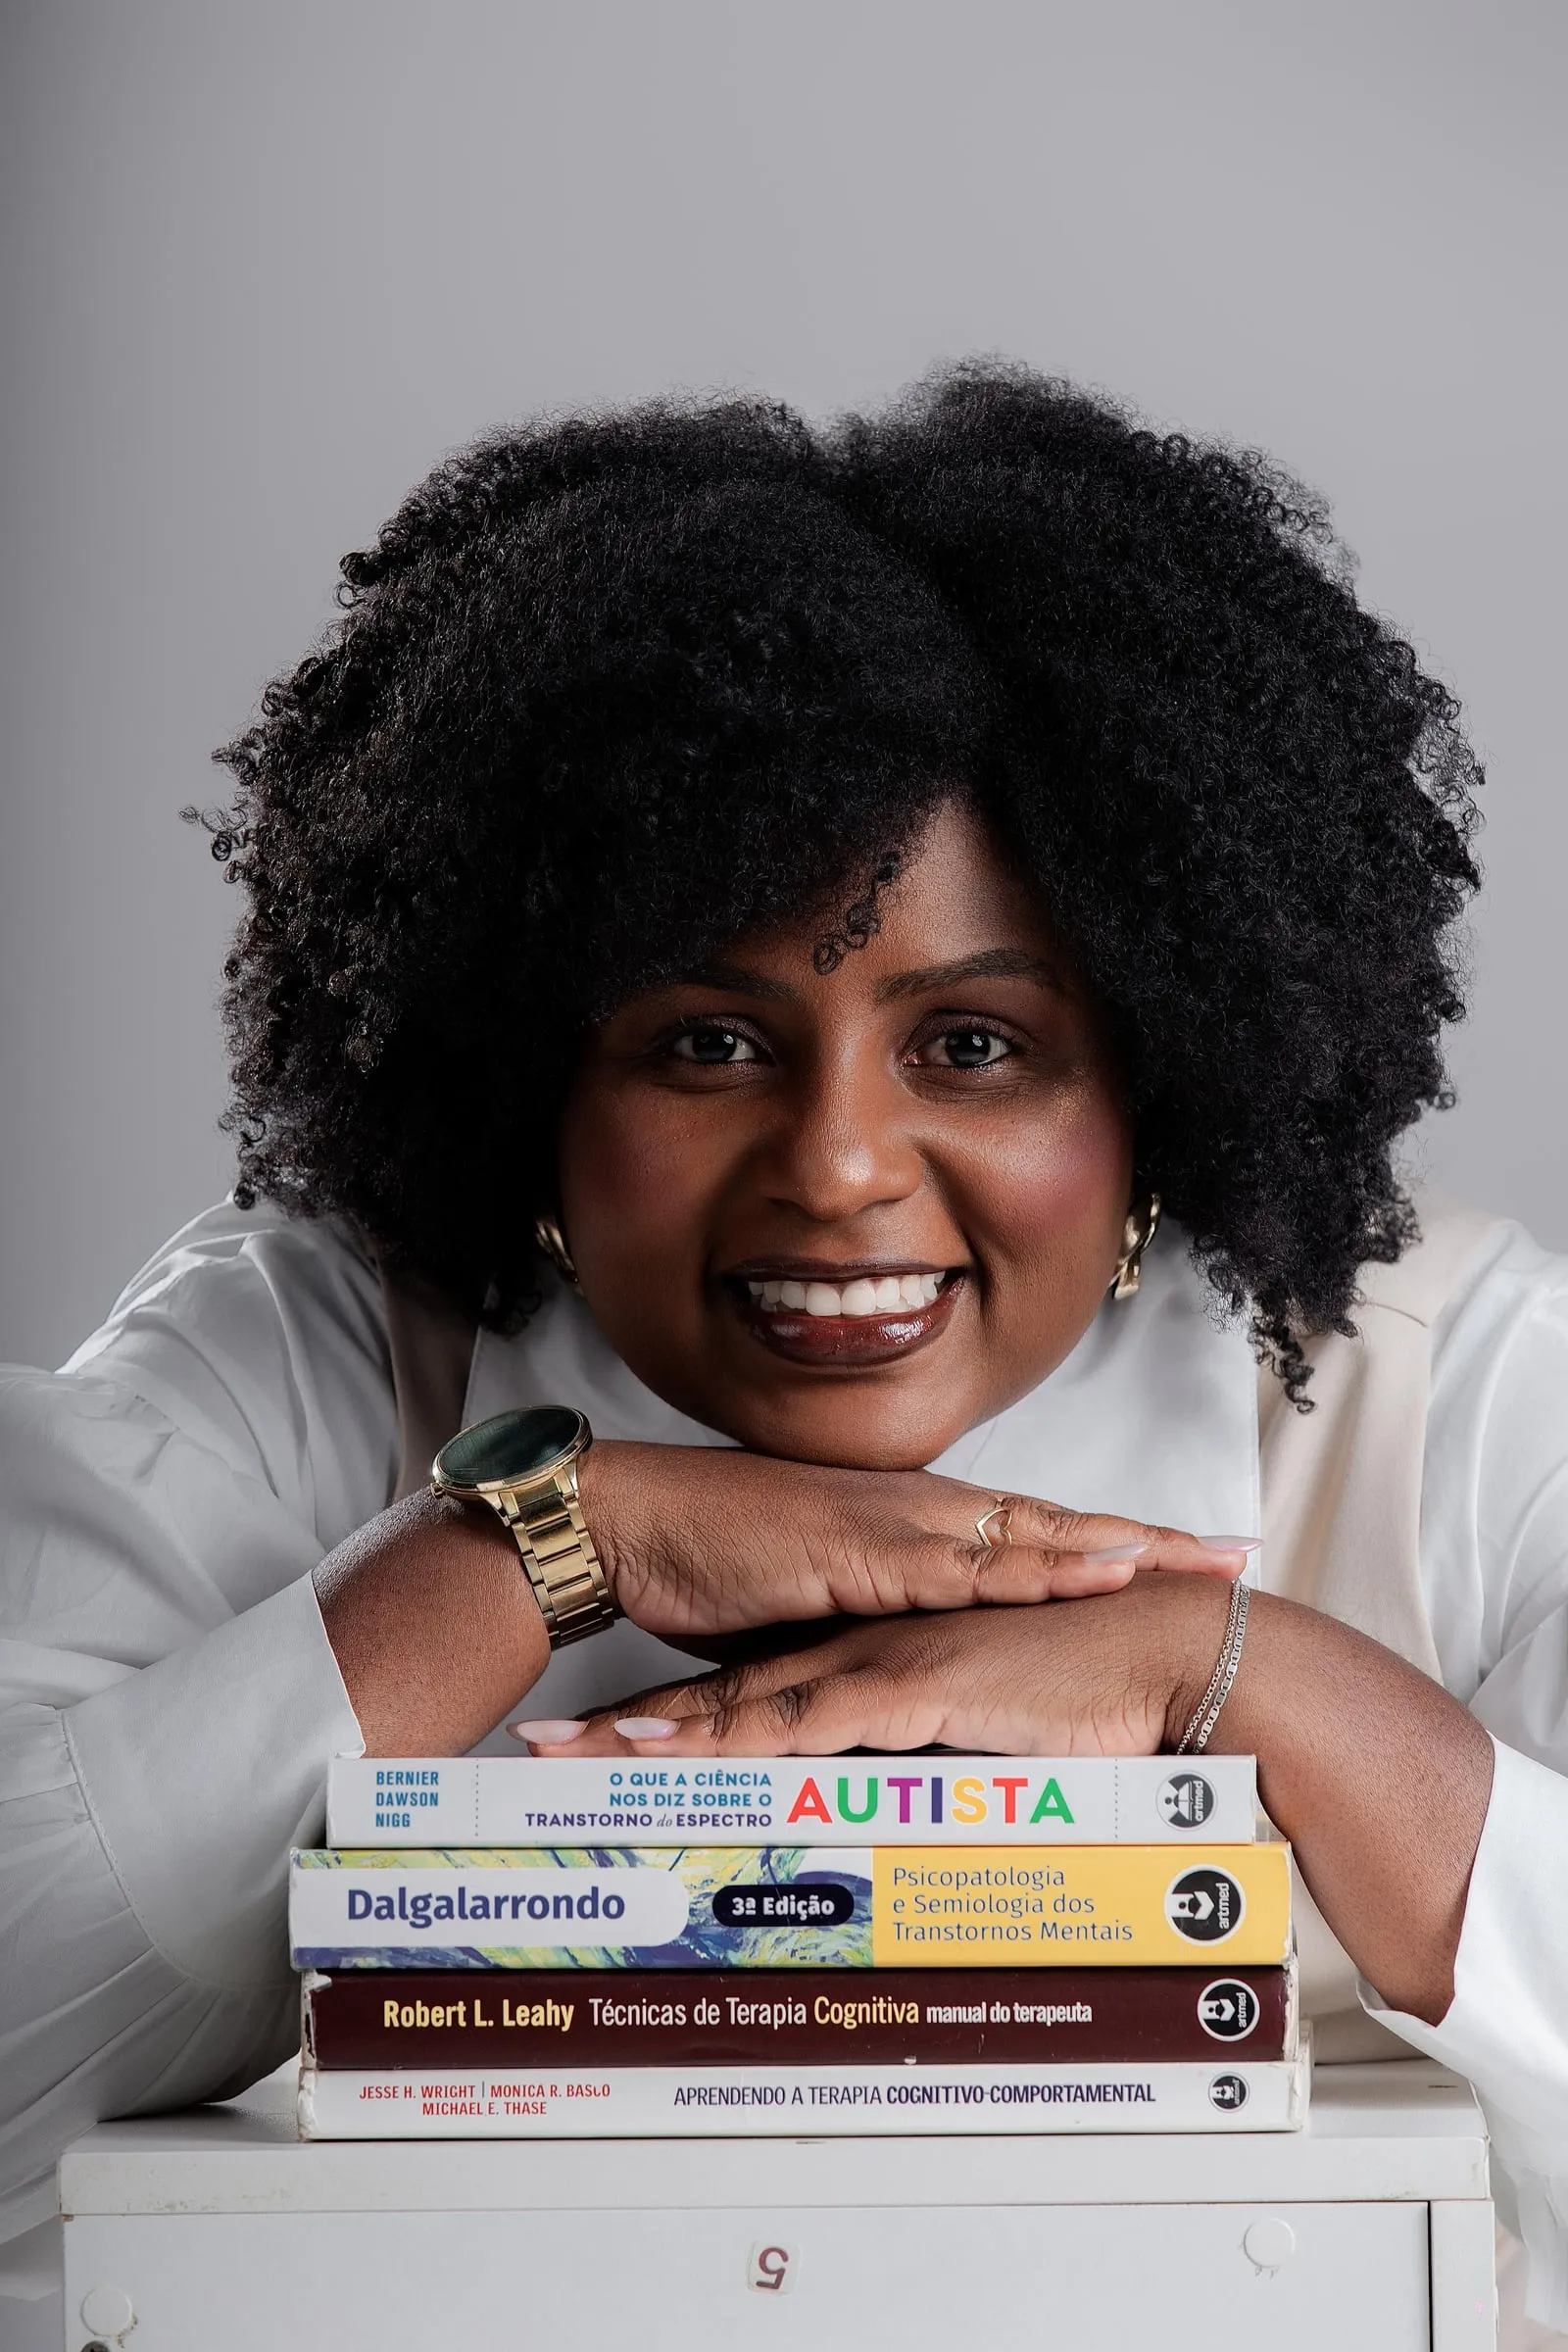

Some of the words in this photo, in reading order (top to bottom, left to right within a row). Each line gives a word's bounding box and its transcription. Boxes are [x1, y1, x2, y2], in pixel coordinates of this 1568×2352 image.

[375, 1771, 439, 1787] BERNIER
[610, 1772, 623, 1787] O
[629, 1772, 668, 1787] QUE
[674, 1773, 688, 1787] A
[694, 1769, 772, 1787] CIÊNCIA
[375, 1791, 439, 1807] DAWSON
[610, 1792, 649, 1807] NOS
[654, 1792, 686, 1807] DIZ
[691, 1792, 753, 1807] SOBRE
[759, 1792, 772, 1807] O
[786, 1776, 1075, 1825] AUTISTA
[1193, 1780, 1204, 1822] artmed
[375, 1812, 411, 1828] NIGG
[524, 1813, 653, 1828] TRANSTORNO
[656, 1812, 673, 1828] do
[676, 1813, 772, 1828] ESPECTRO
[894, 1865, 1065, 1891] Psicopatologia
[347, 1886, 625, 1930] Dalgalarrondo
[762, 1893, 835, 1922] Edição
[893, 1898, 906, 1914] e
[913, 1892, 1044, 1919] Semiologia
[1053, 1892, 1095, 1914] dos
[1215, 1882, 1230, 1930] artmed
[893, 1921, 1032, 1941] Transtornos
[1040, 1919, 1133, 1941] Mentais
[383, 1999, 467, 2028] Robert
[473, 1998, 495, 2028] L.
[502, 1998, 575, 2033] Leahy
[588, 1997, 687, 2027] Técnicas
[693, 1997, 720, 2026] de
[725, 1996, 807, 2031] Terapia
[813, 1995, 919, 2030] Cognitiva
[926, 2000, 987, 2024] manual
[989, 2000, 1011, 2024] do
[1012, 2001, 1093, 2028] terapeuta
[1235, 1991, 1248, 2029] artmed
[359, 2085, 400, 2099] JESSE
[404, 2084, 416, 2099] H.
[420, 2084, 476, 2099] WRIGHT
[490, 2084, 546, 2098] MONICA
[550, 2083, 563, 2098] R.
[673, 2085, 786, 2106] APRENDENDO
[791, 2085, 804, 2105] A
[808, 2085, 882, 2105] TERAPIA
[422, 2101, 484, 2116] MICHAEL
[488, 2101, 500, 2116] E.
[503, 2101, 547, 2116] THASE
[756, 2246, 789, 2290] 5
